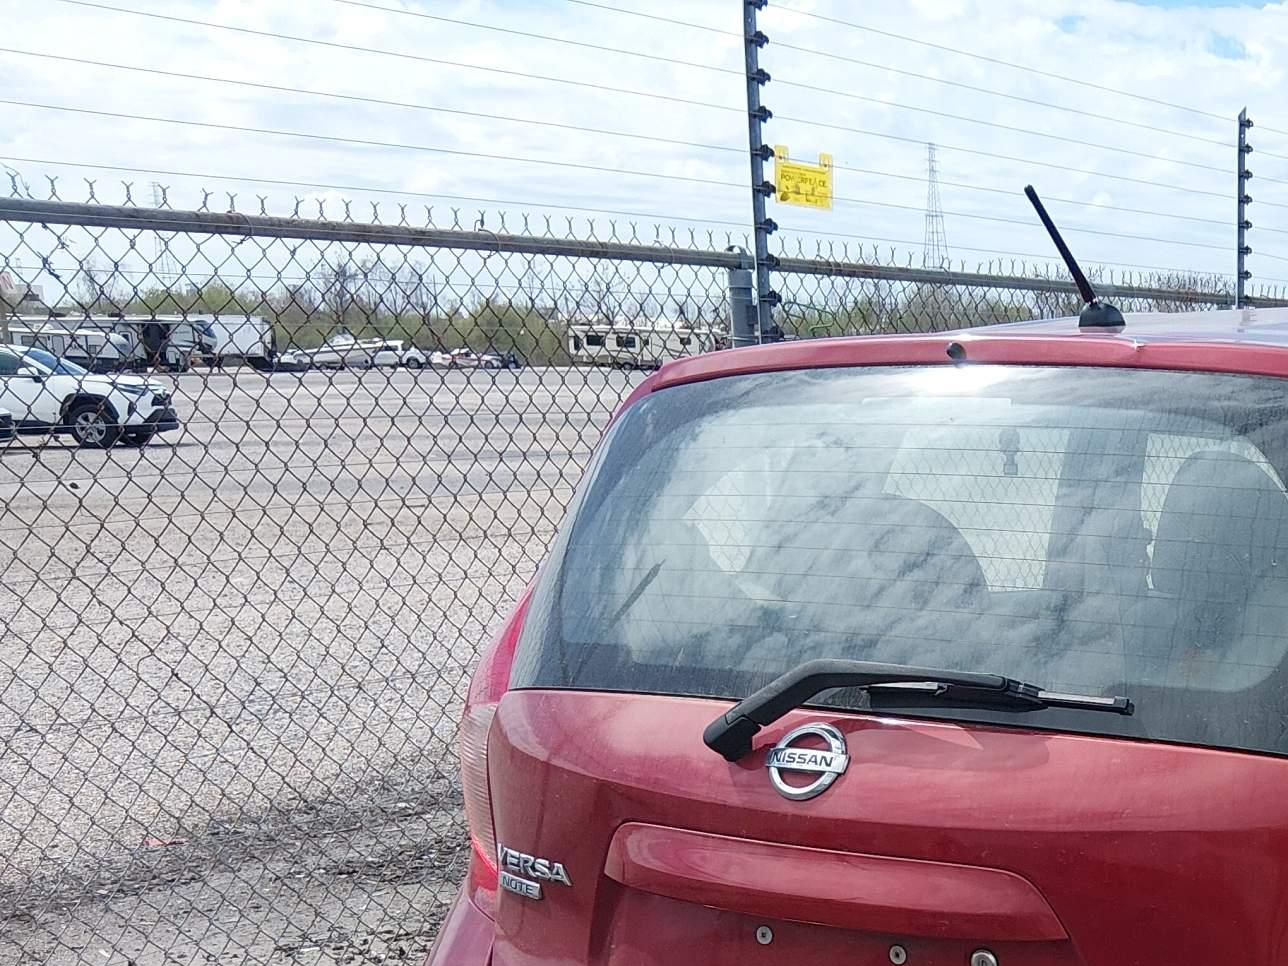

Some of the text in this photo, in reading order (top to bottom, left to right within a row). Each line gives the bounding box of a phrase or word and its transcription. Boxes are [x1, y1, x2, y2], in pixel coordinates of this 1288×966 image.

[770, 750, 834, 768] NISSAN
[497, 843, 572, 887] VERSA
[502, 876, 537, 896] NOTE
